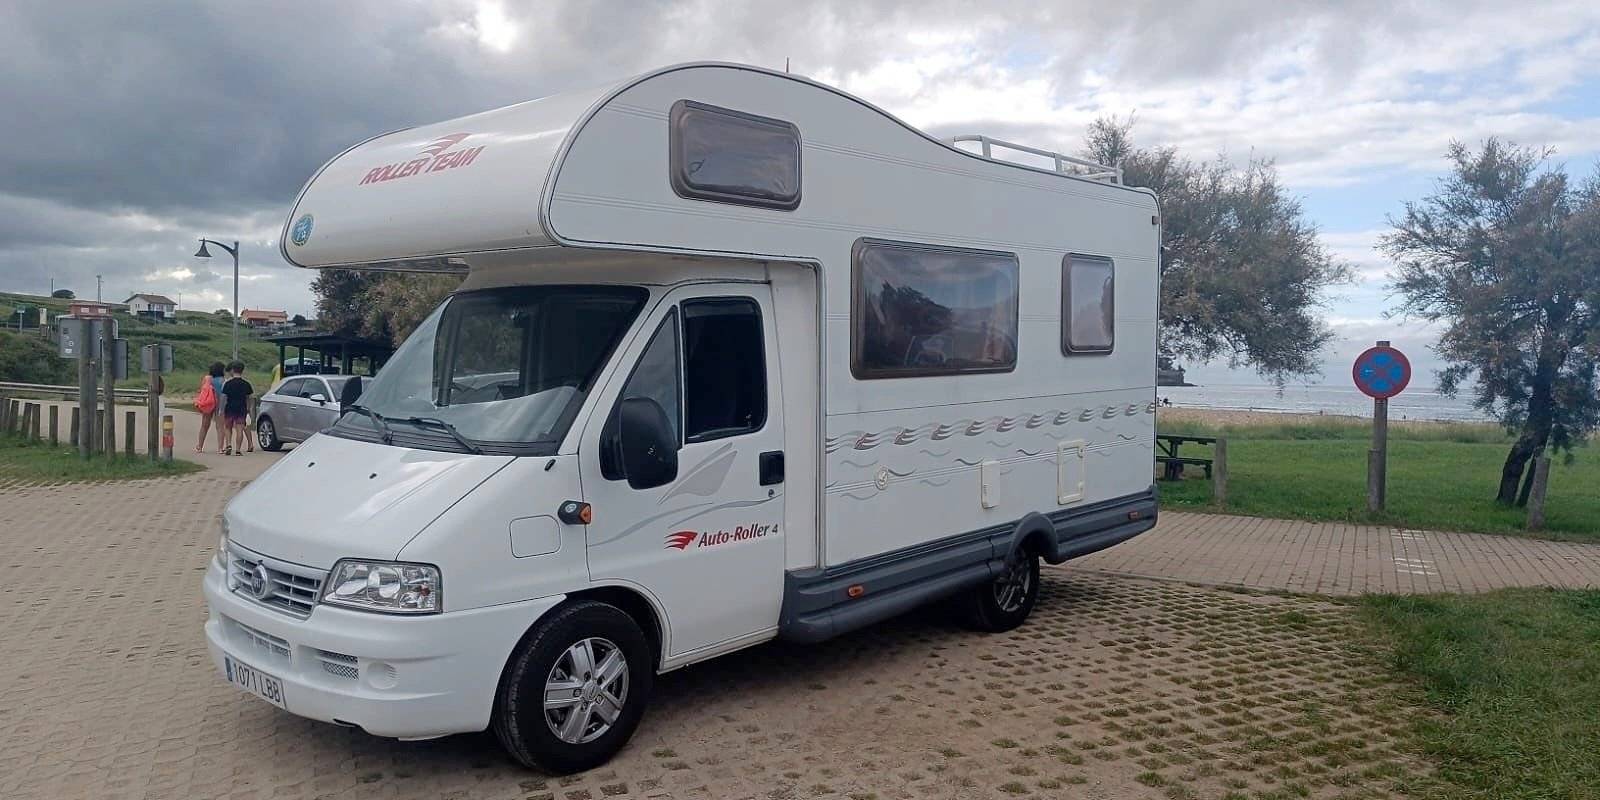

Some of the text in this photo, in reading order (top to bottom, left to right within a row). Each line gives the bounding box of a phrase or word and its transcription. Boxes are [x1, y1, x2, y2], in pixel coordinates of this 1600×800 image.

[359, 145, 486, 186] ROLLER TEAM
[698, 523, 778, 548] Auto-Roller 4
[233, 662, 281, 703] 1071 LBB
